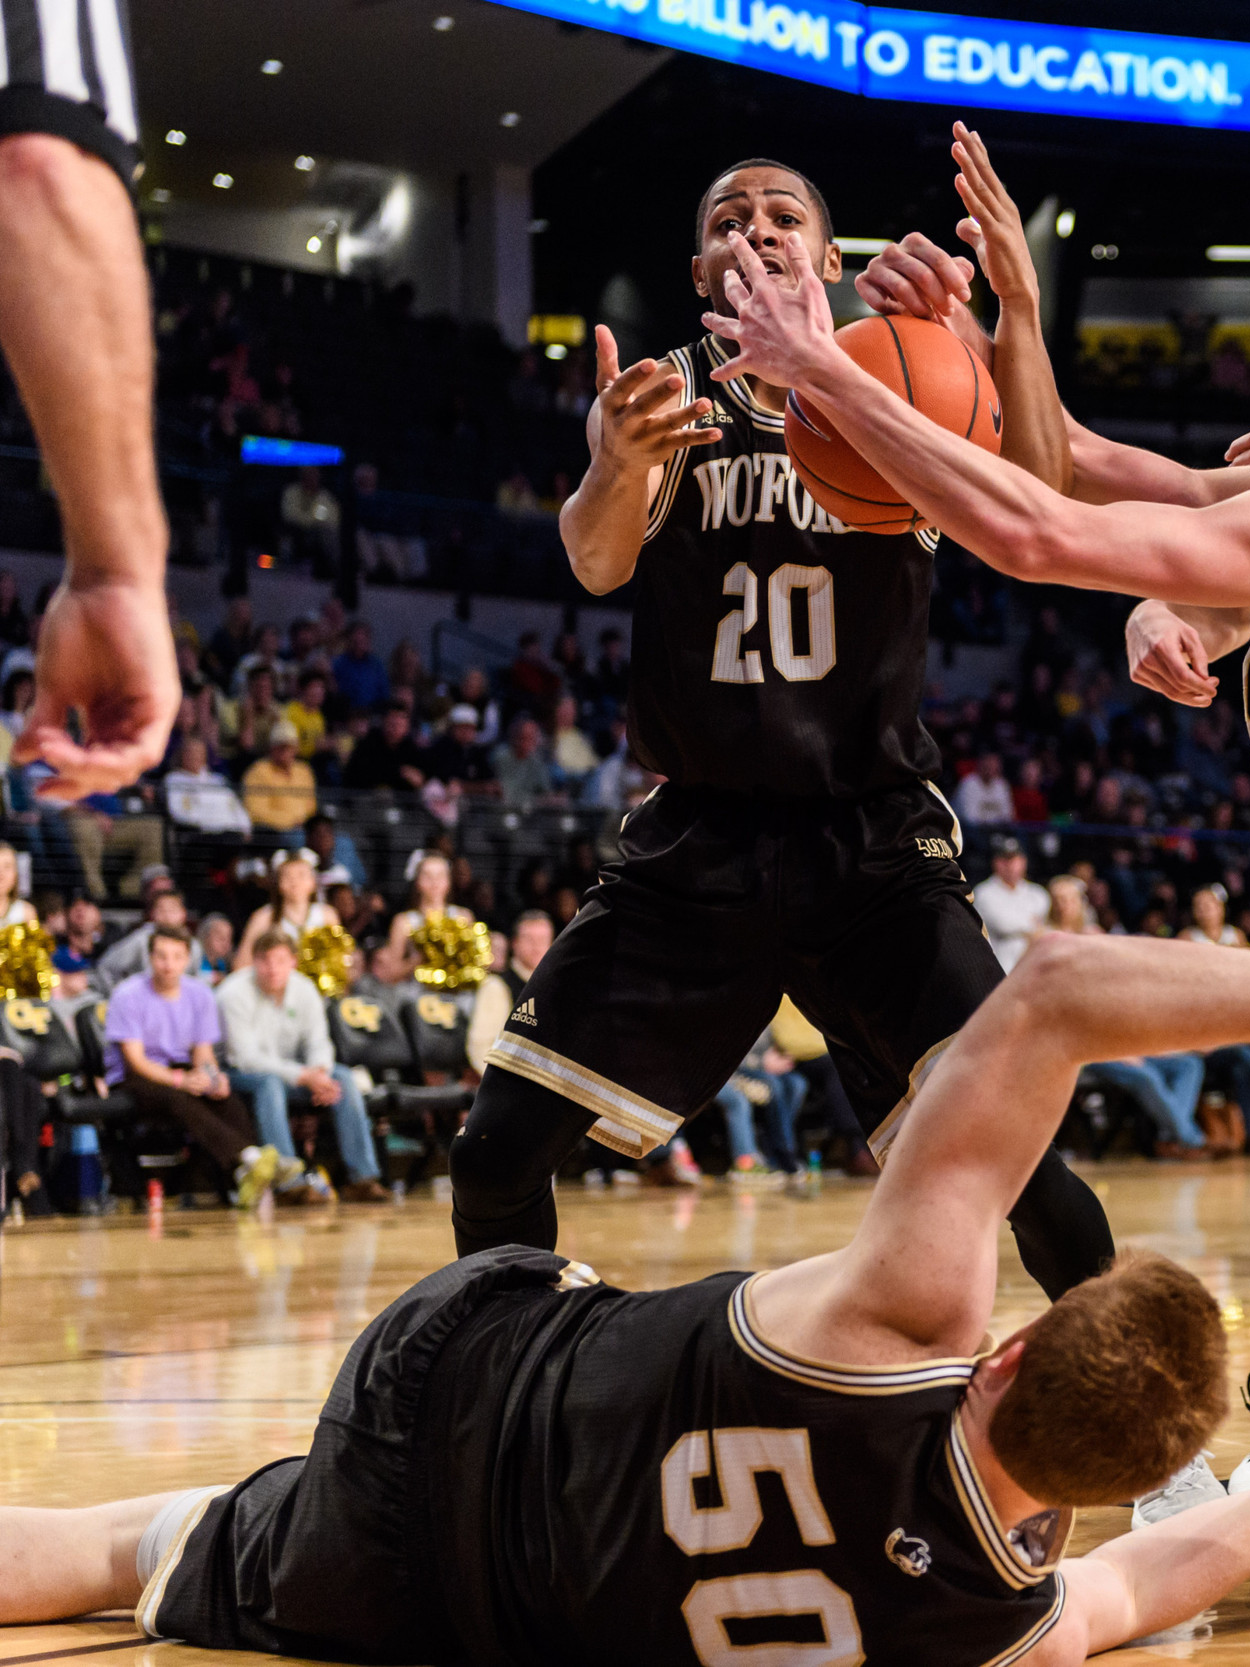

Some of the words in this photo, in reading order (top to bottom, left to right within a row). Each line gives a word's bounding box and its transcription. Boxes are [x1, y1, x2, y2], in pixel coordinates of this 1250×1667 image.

[835, 22, 910, 77] TO
[923, 34, 1243, 107] EDUCATION.
[710, 561, 837, 684] 20
[511, 1012, 540, 1028] adidas
[660, 1425, 867, 1667] 50
